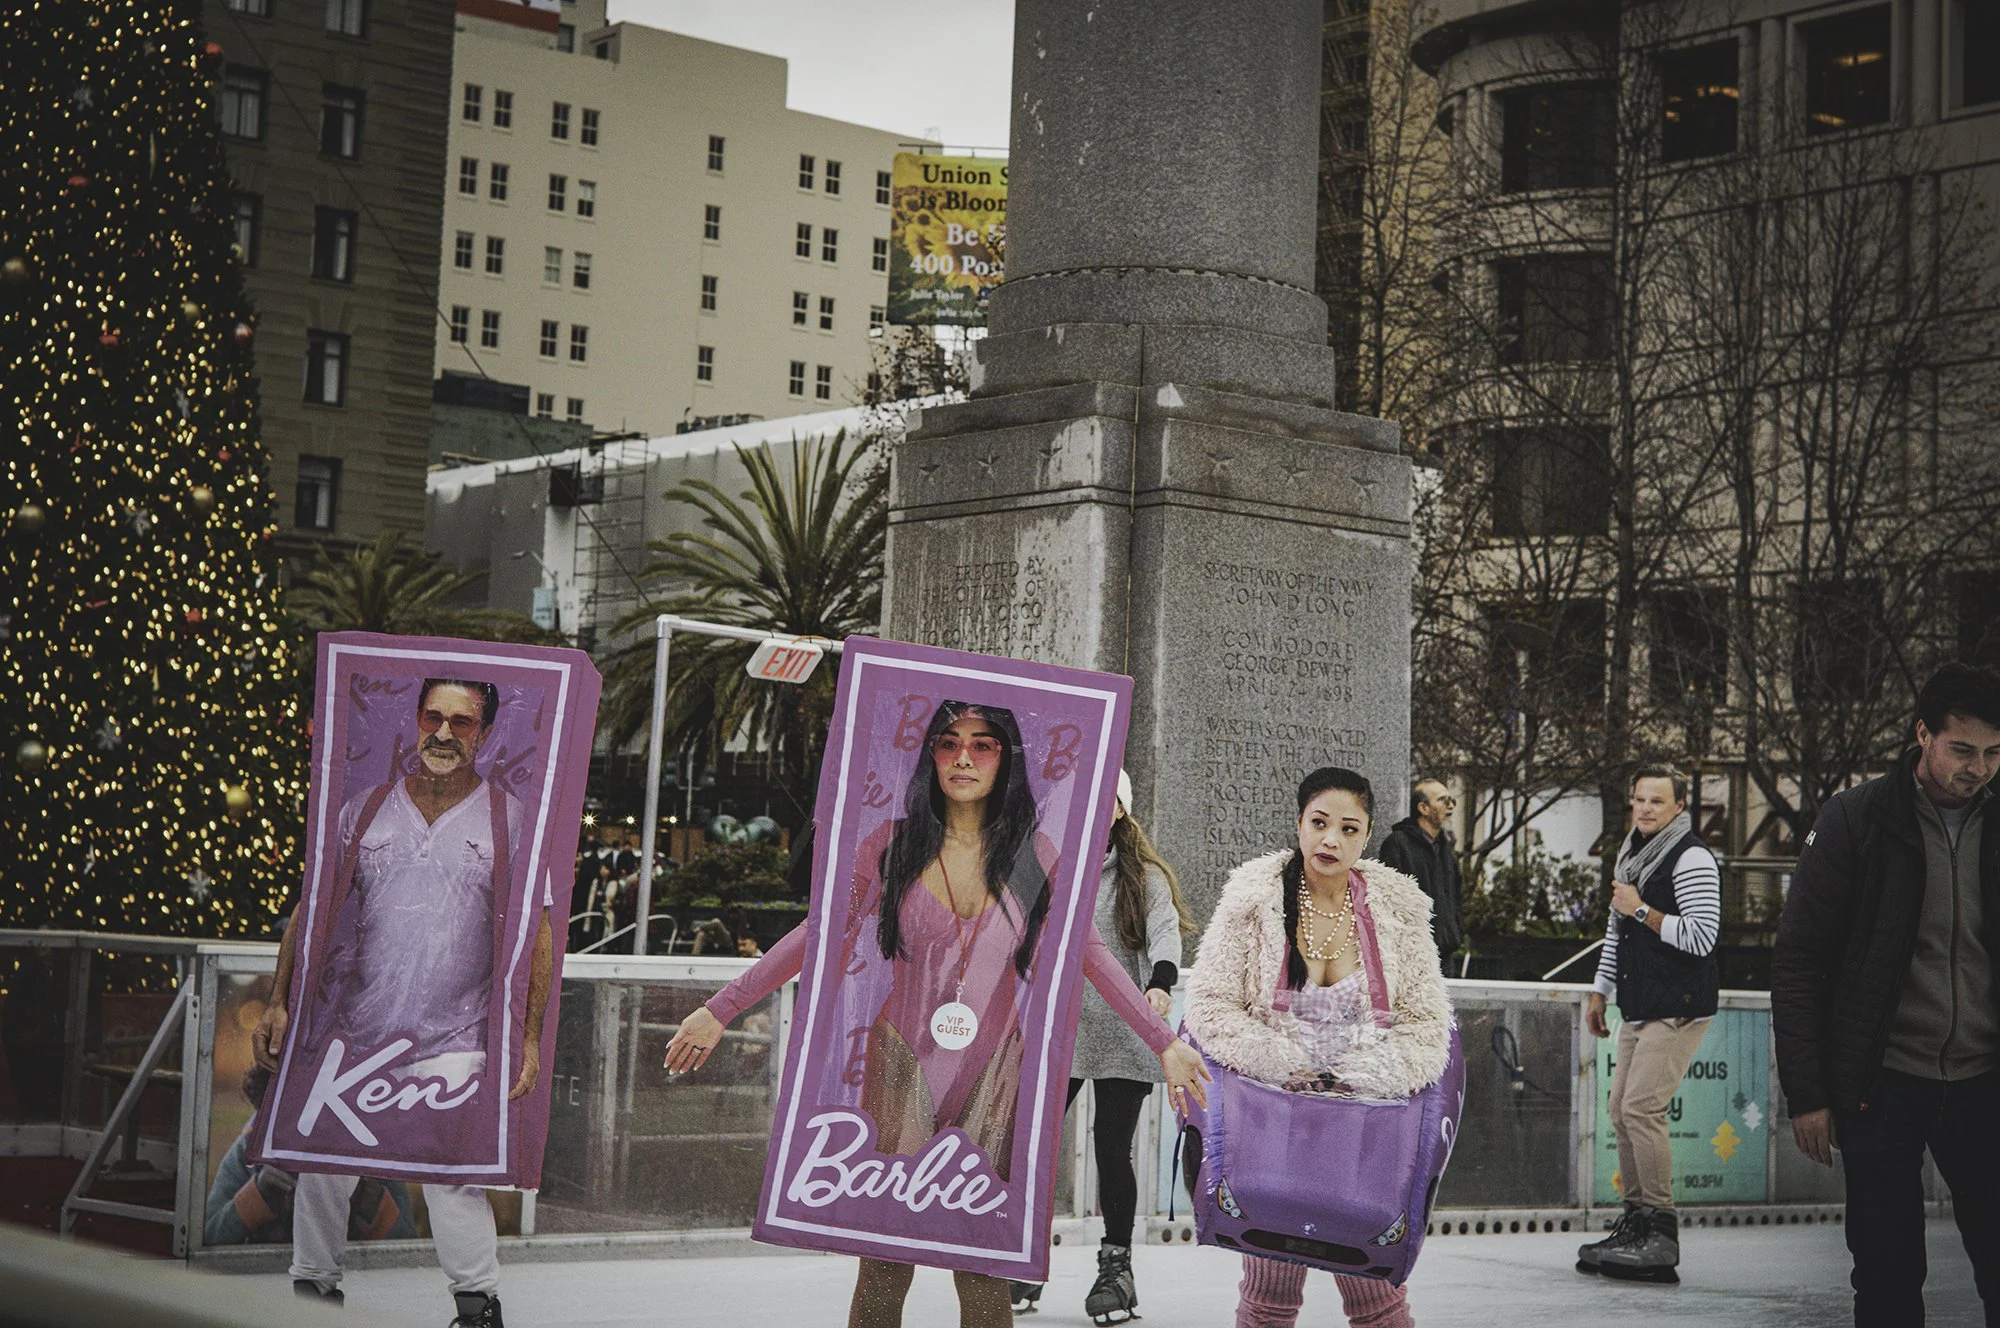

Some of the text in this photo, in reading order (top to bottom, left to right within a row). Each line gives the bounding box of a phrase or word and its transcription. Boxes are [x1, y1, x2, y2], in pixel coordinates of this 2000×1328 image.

[922, 163, 992, 185] Union
[920, 190, 936, 209] is
[947, 222, 979, 246] Be
[909, 253, 954, 275] 400
[955, 556, 1046, 582] ERECTED BY
[1203, 560, 1283, 589] SECRETARY
[1286, 572, 1305, 590] OF
[1307, 573, 1336, 596] THE
[1025, 579, 1044, 597] OF
[1225, 586, 1279, 608] JOHN
[1305, 596, 1356, 619] LONG
[1222, 629, 1356, 662] COMMODORE
[760, 646, 817, 680] EXIT
[1222, 652, 1352, 682] GEORGE DEWEY
[1225, 674, 1279, 697] APRIL
[1205, 760, 1261, 783] STATES
[936, 1024, 972, 1038] GUEST
[946, 1015, 964, 1027] VIP
[297, 1038, 480, 1147] Ken
[787, 1111, 1008, 1216] Barbie
